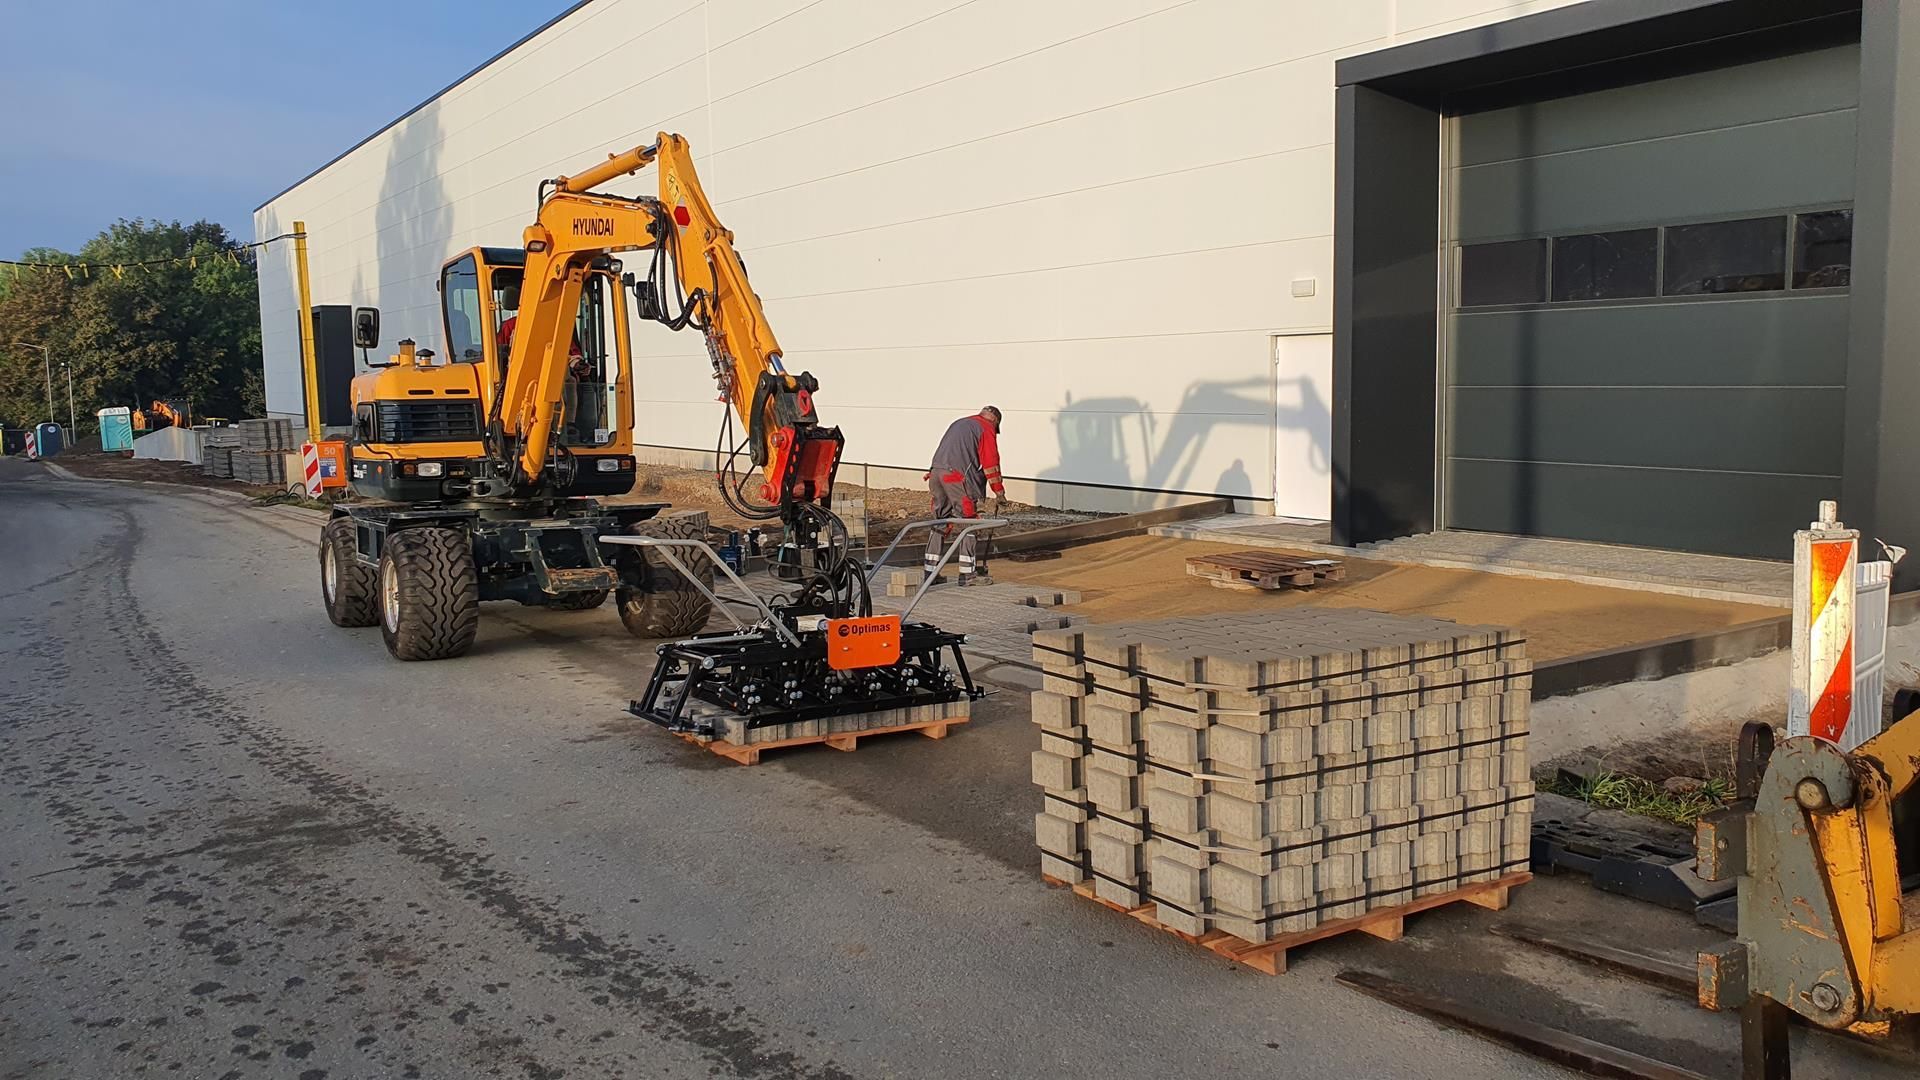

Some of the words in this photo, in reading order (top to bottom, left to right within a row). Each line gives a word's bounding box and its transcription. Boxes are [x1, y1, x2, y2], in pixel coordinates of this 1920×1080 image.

[572, 218, 614, 236] HYUNDAI
[323, 447, 336, 455] 50
[851, 624, 891, 636] Optimas
